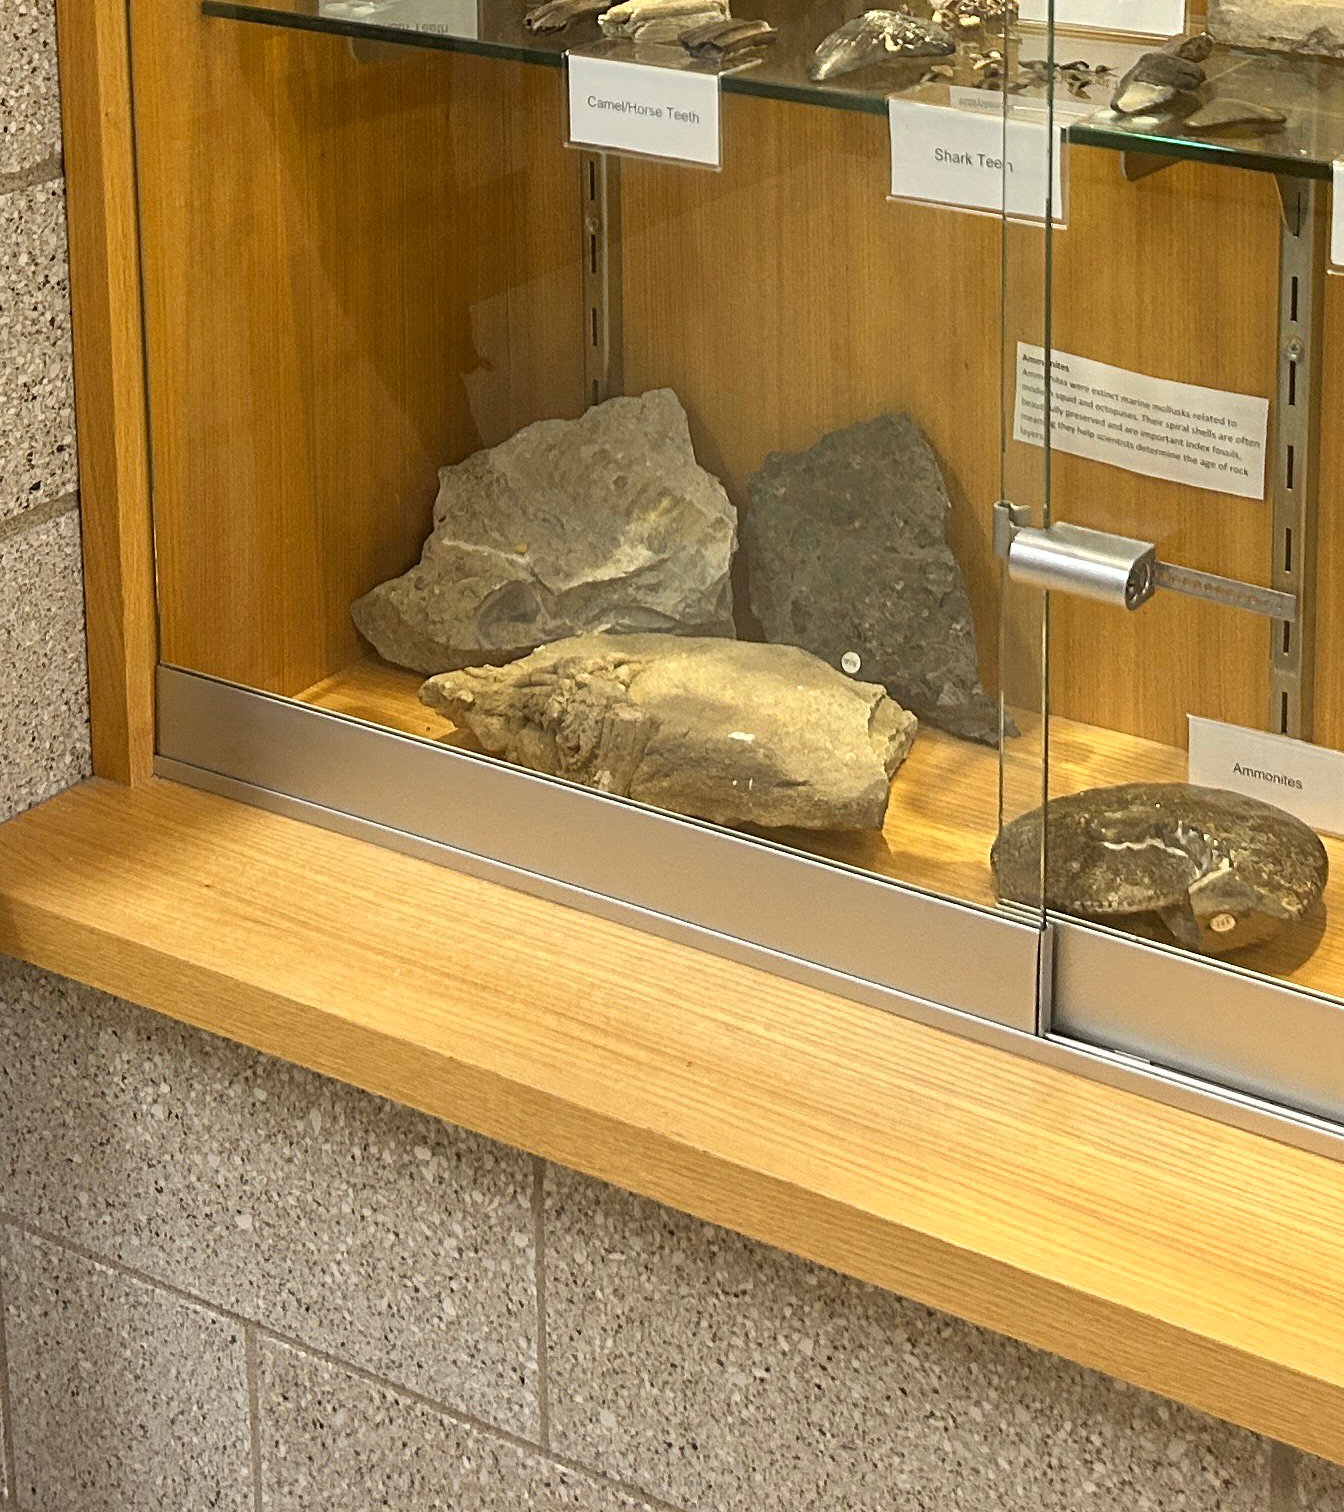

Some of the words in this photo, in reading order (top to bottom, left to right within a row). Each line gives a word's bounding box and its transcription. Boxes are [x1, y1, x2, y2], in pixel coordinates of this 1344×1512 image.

[588, 96, 662, 118] Camel/Horse
[666, 106, 700, 124] Teeth
[934, 148, 972, 166] Shark
[1233, 762, 1303, 790] Ammonites
